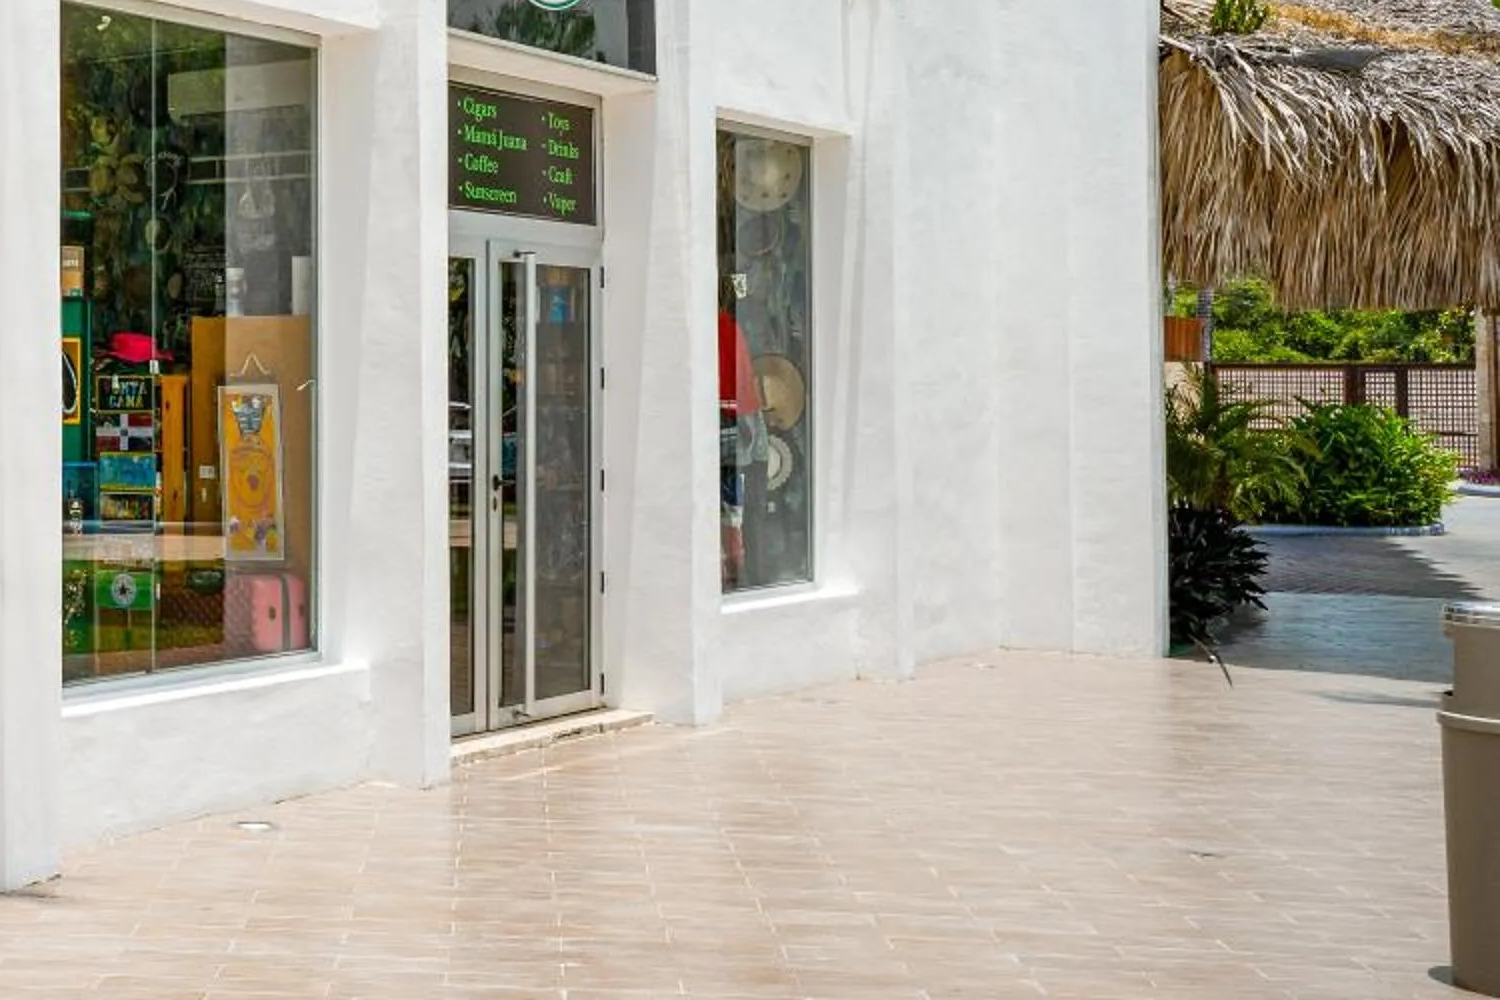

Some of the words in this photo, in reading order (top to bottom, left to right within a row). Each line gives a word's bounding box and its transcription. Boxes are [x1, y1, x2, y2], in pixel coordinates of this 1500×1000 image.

[463, 96, 498, 123] Cigars
[548, 138, 580, 160] Drinks
[464, 152, 499, 175] Coffee
[465, 181, 517, 204] Sunscreen
